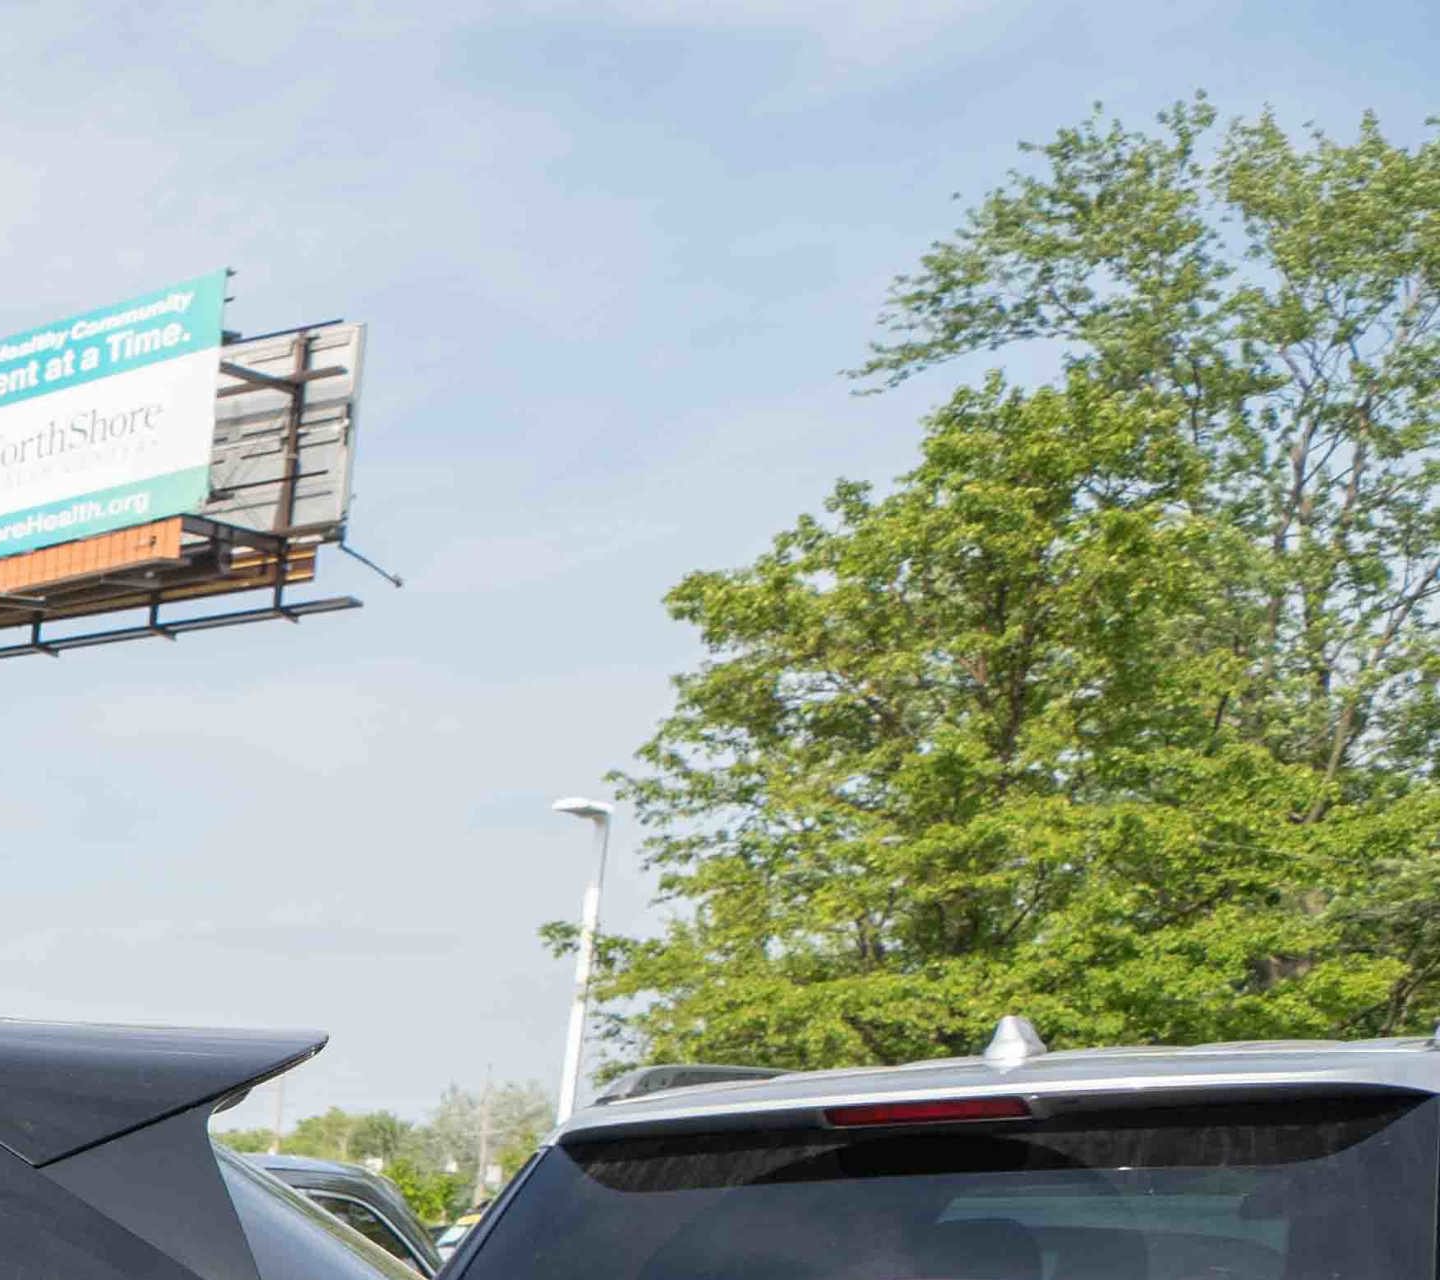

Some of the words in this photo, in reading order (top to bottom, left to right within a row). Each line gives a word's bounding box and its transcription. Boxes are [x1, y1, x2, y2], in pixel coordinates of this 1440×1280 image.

[70, 290, 196, 341] Community
[44, 349, 76, 382] at
[80, 346, 101, 372] a
[105, 322, 193, 363] Time.
